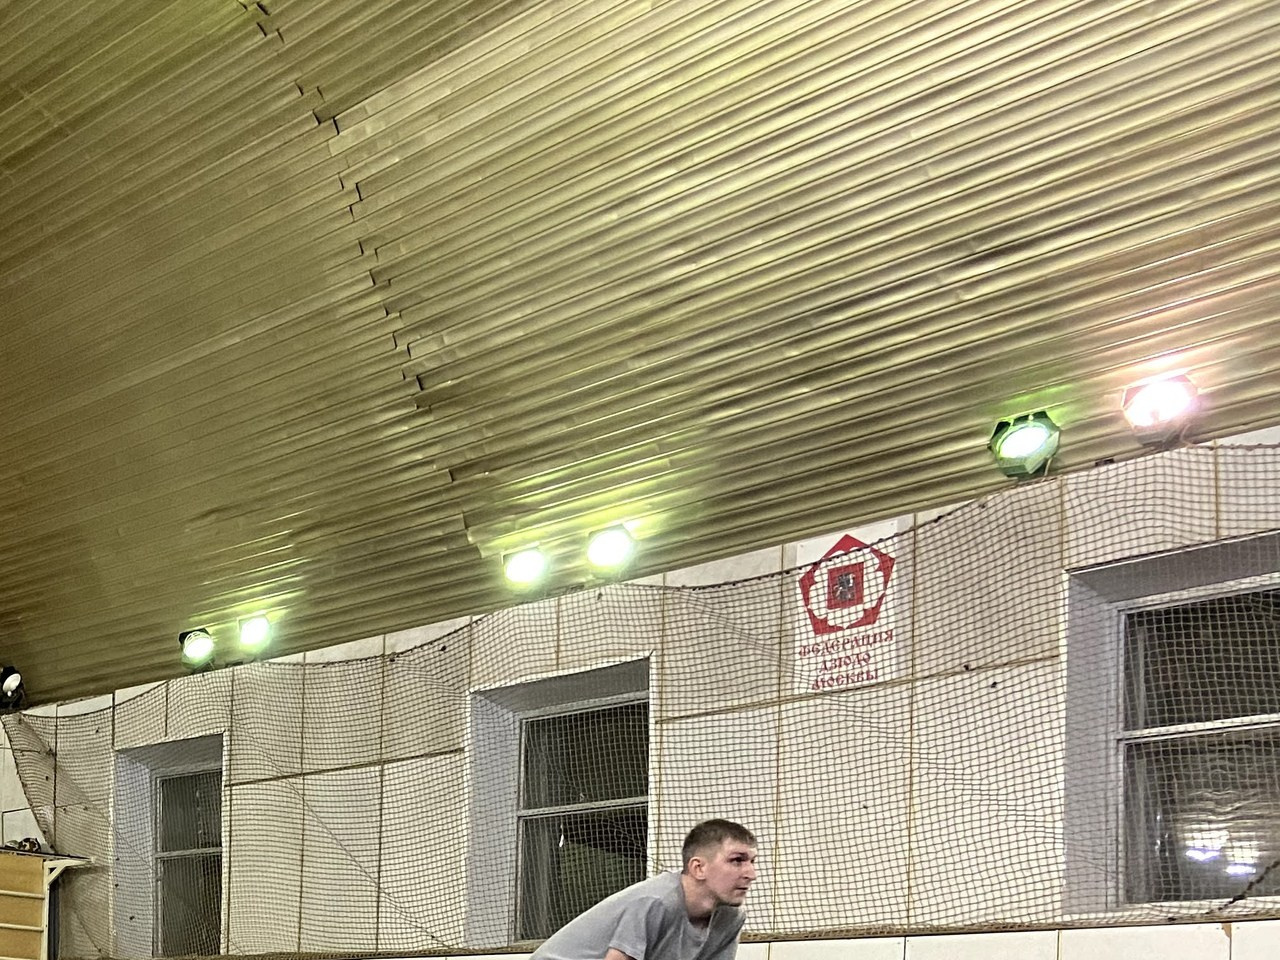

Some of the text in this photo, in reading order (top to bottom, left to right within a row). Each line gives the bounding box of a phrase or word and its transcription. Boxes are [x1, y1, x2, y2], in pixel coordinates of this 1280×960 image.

[799, 629, 893, 657] ФЕДЕРАЦИЯ
[819, 652, 871, 673] ДЗЮДО
[811, 668, 879, 690] МОСКВЫ
